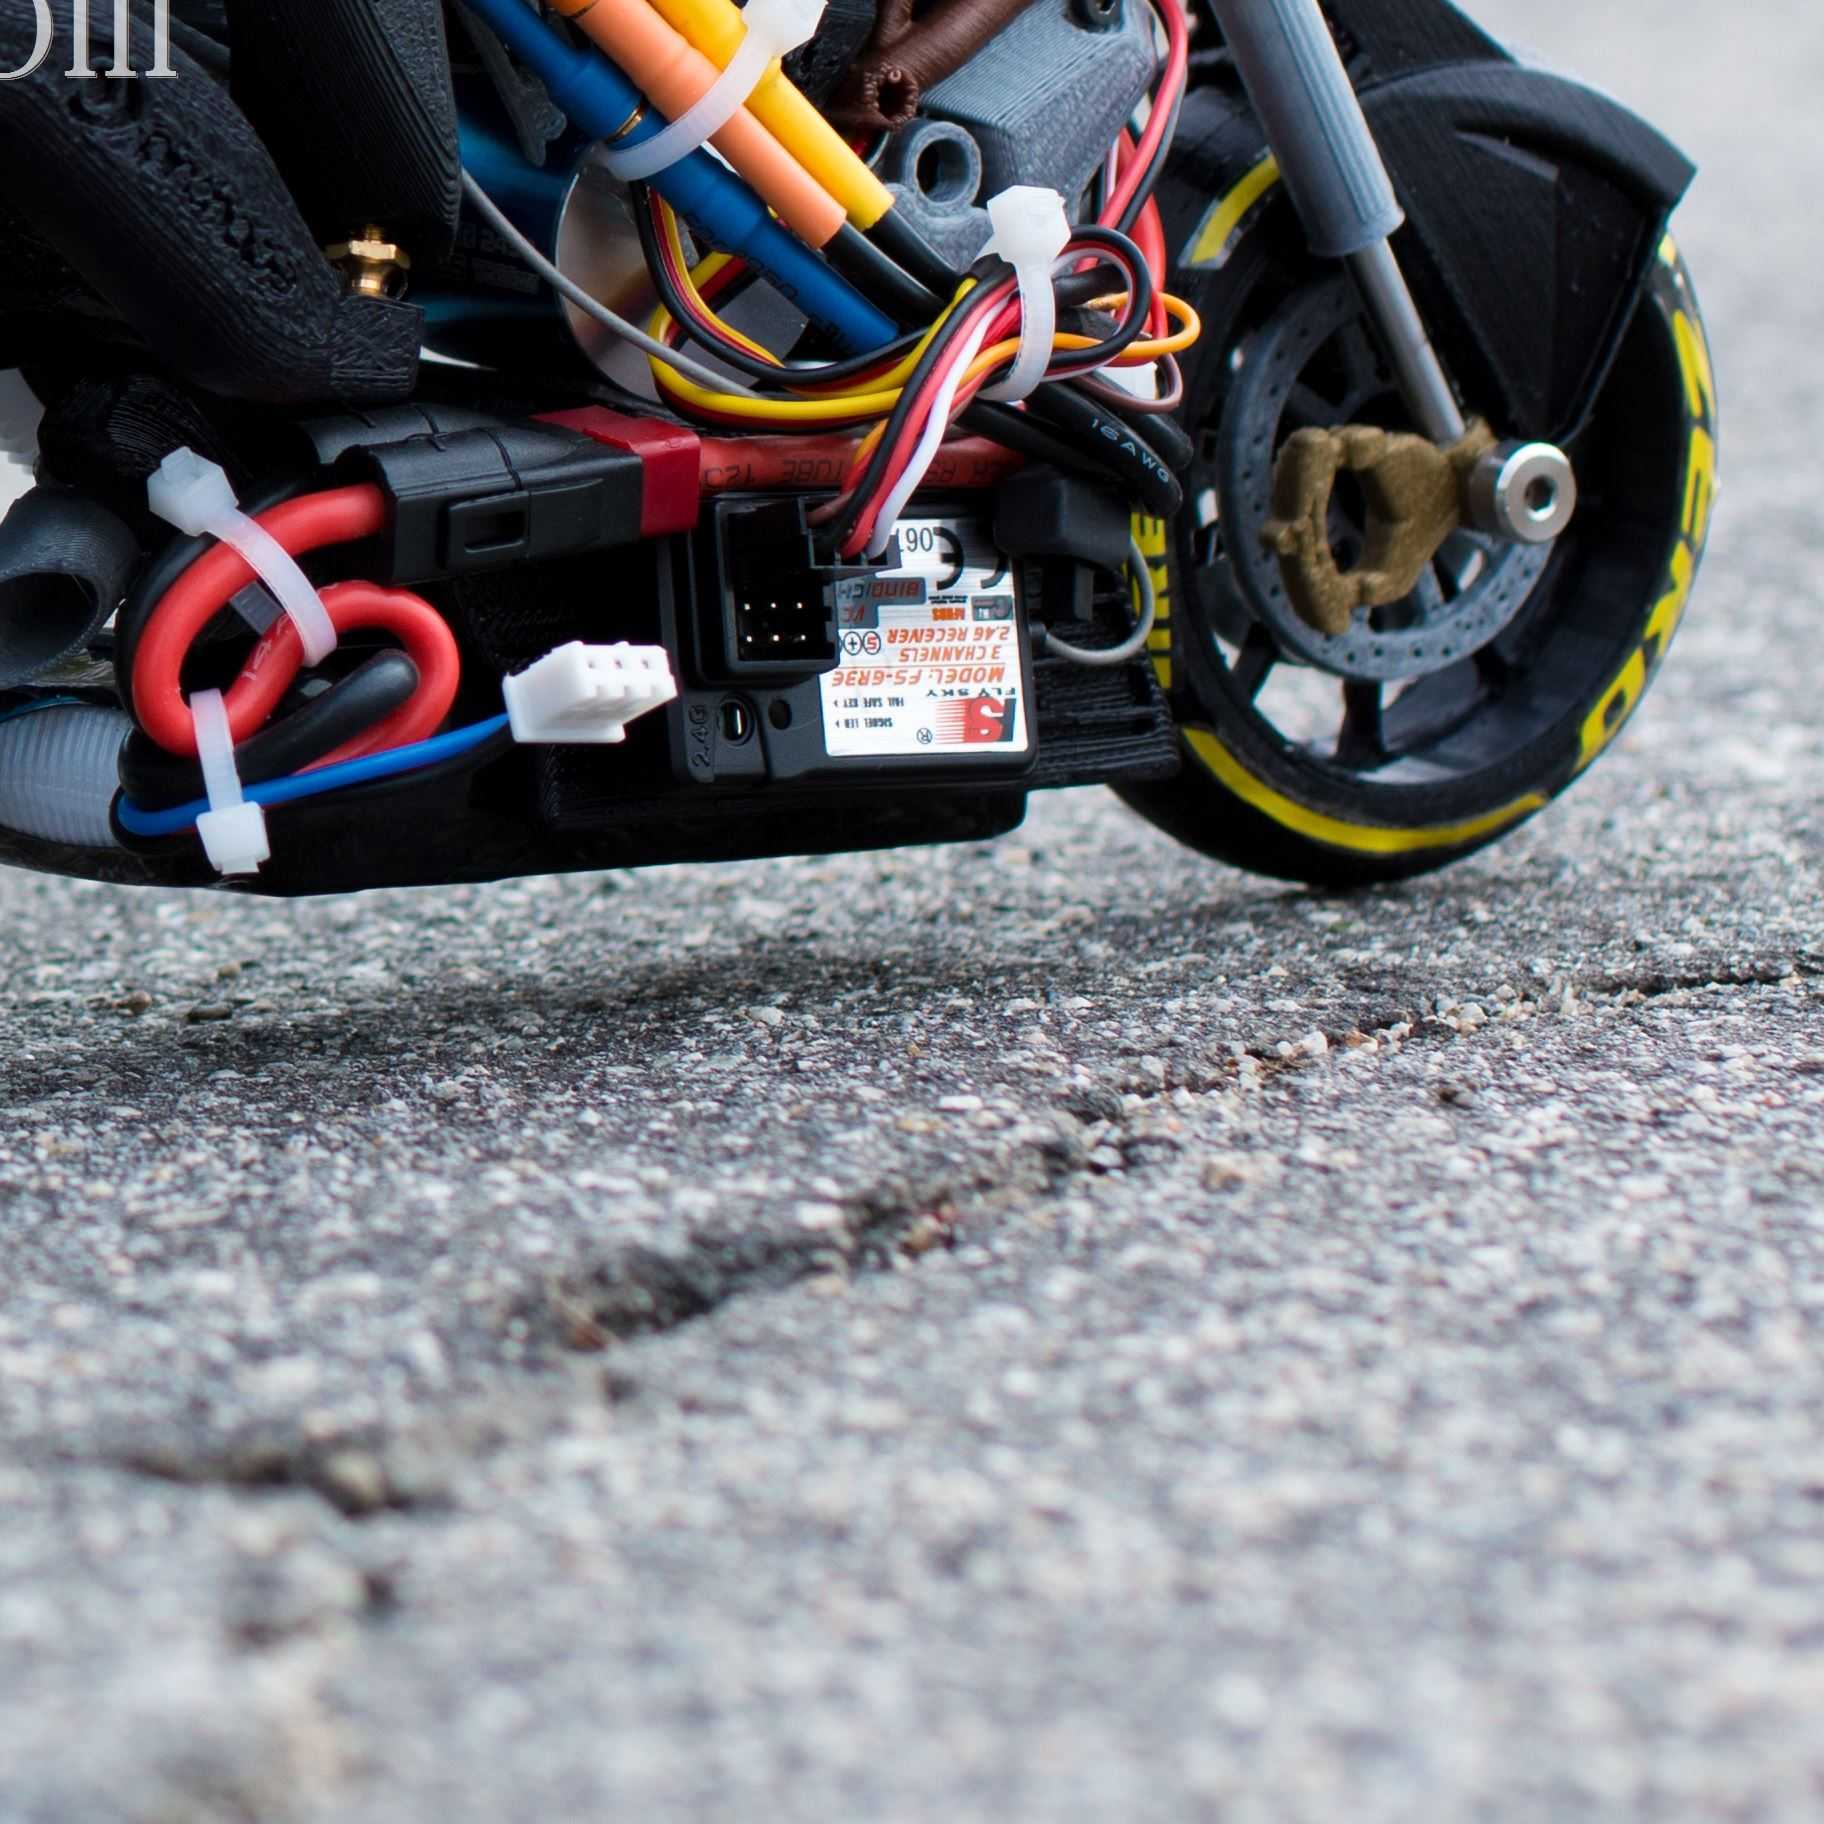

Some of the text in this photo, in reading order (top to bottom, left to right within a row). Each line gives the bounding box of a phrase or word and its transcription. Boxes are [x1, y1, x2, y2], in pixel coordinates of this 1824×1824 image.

[886, 627, 968, 644] RECEIVER
[897, 645, 1002, 663] 3 CHANNELS
[929, 665, 1005, 685] MODEL:
